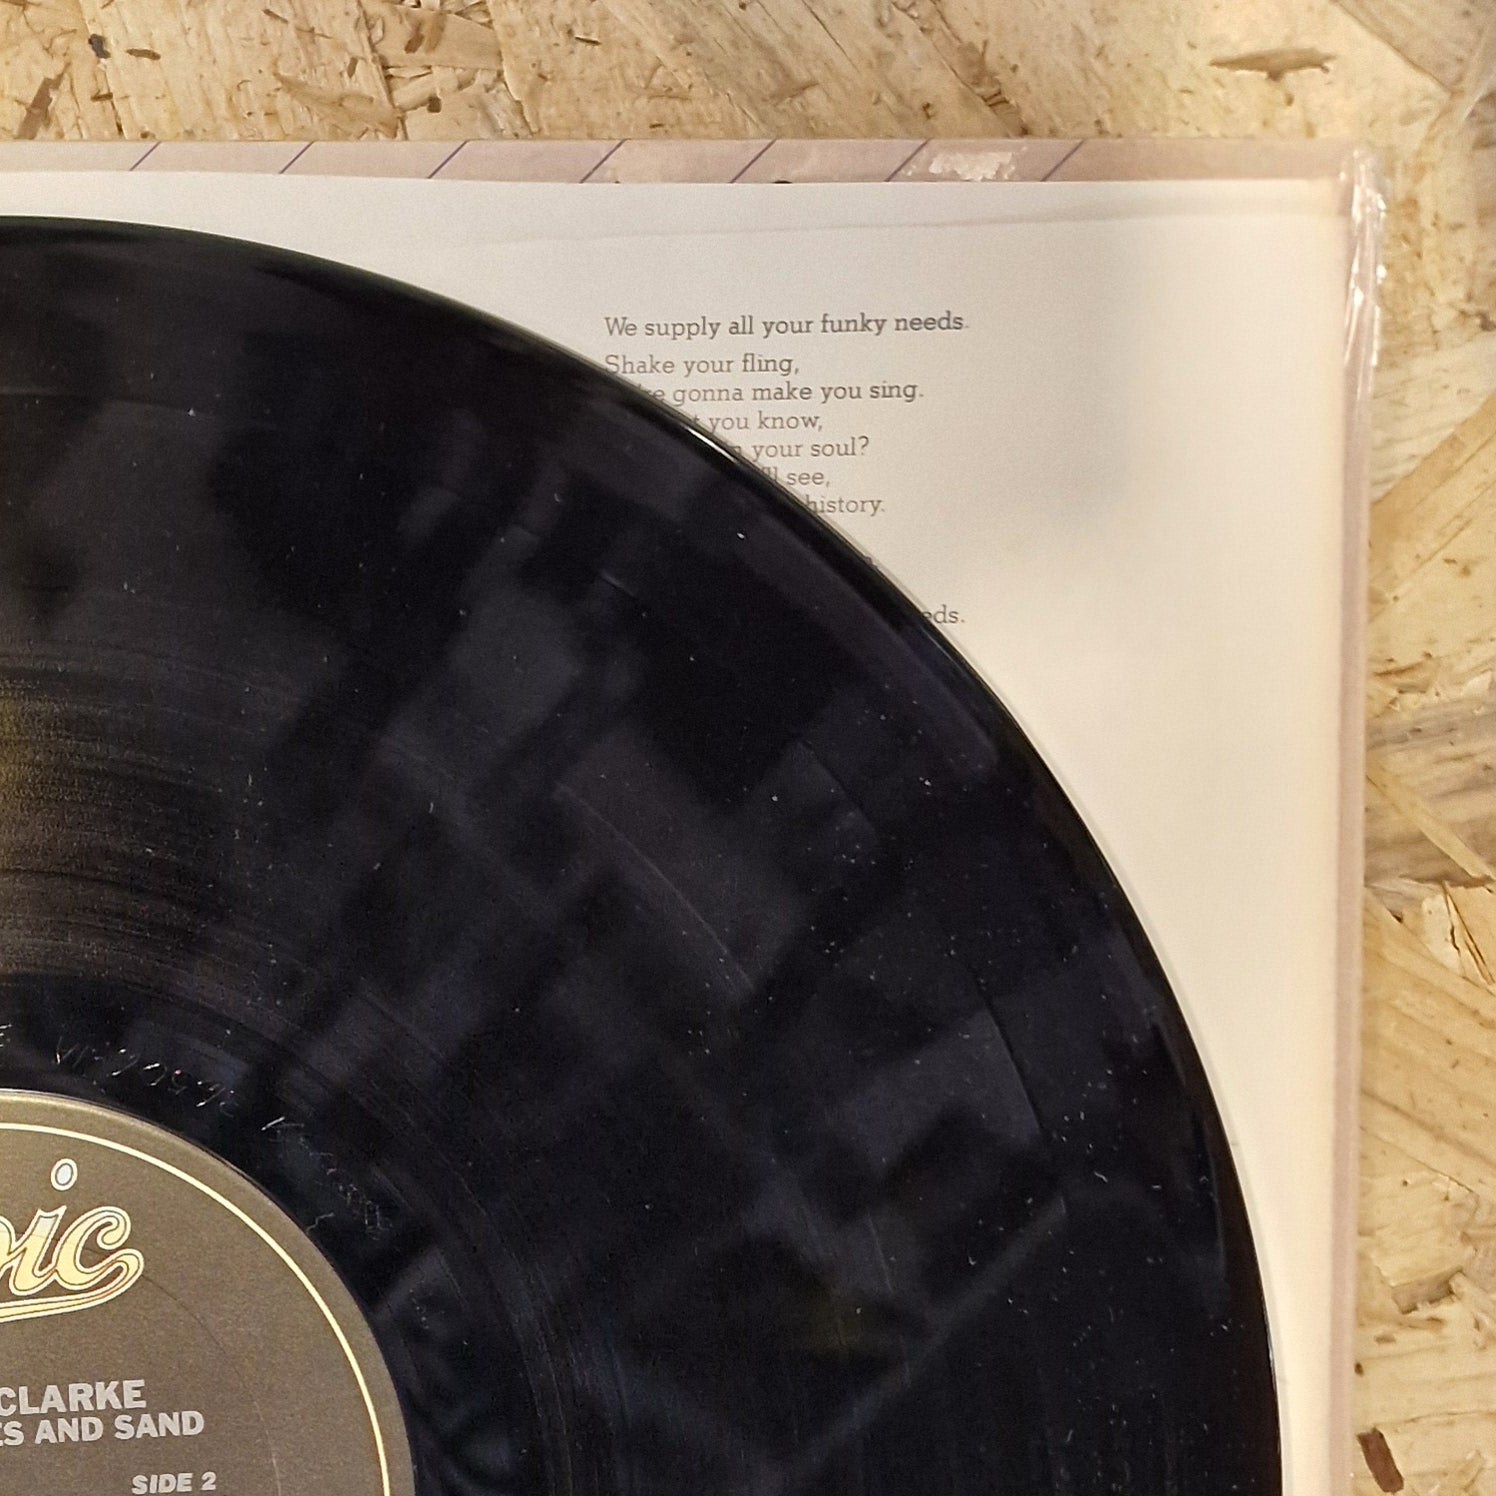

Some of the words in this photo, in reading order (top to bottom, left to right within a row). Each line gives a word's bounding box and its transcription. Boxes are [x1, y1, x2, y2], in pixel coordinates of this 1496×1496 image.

[605, 316, 638, 337] We
[644, 315, 720, 340] supply
[728, 315, 754, 336] all
[762, 318, 814, 340] your
[820, 313, 887, 336] funky
[894, 310, 970, 332] needs.
[605, 354, 675, 375] Shake
[683, 358, 734, 378] your
[742, 353, 800, 376] fling,
[672, 386, 744, 405] gonna
[752, 381, 813, 402] make
[820, 385, 862, 405] you
[869, 381, 925, 404] sing.
[708, 414, 750, 434] you
[758, 410, 823, 432] know,
[752, 442, 802, 461] your
[810, 436, 869, 457] soul?
[786, 469, 831, 488] see,
[805, 494, 886, 517] history.
[35, 1416, 104, 1444] AND
[114, 1411, 204, 1440] SAND
[132, 1473, 193, 1495] SIDE
[201, 1472, 217, 1491] 2
